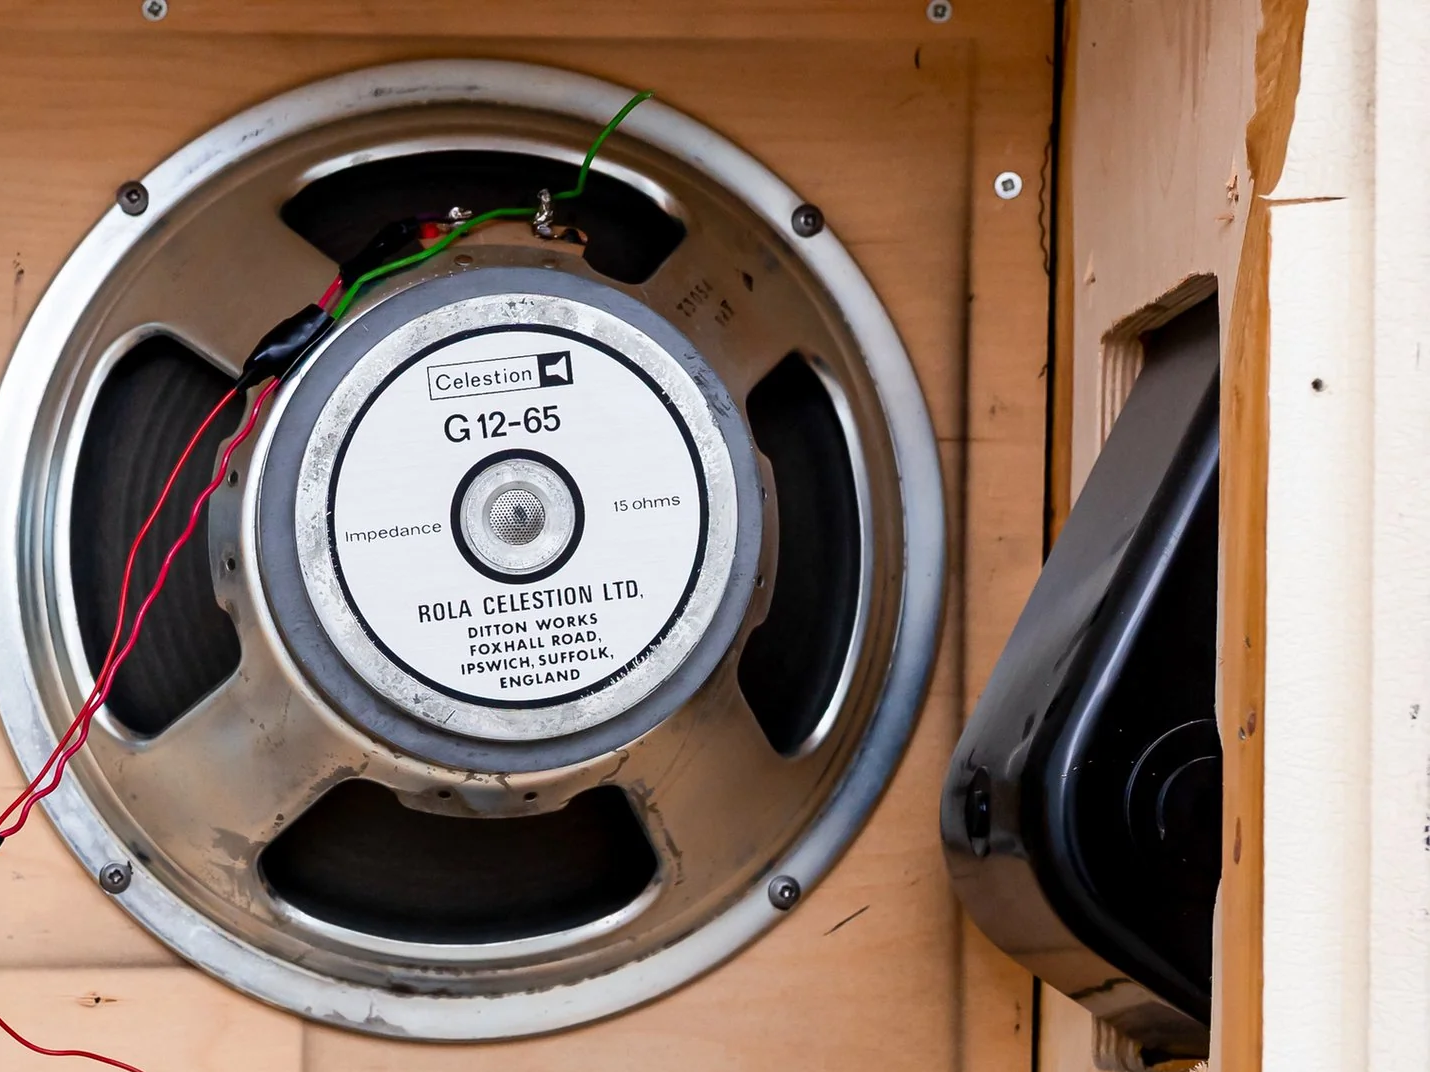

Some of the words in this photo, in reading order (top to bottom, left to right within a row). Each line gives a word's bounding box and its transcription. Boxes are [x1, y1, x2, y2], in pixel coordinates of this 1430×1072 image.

[434, 367, 533, 392] Celestion
[613, 499, 629, 512] 15
[632, 494, 681, 511] ohms
[345, 521, 442, 543] Impedance
[418, 599, 472, 623] ROLA
[483, 585, 592, 615] CELESTION
[468, 621, 528, 638] DITTON
[535, 613, 598, 630] WORKS
[470, 636, 545, 656] FOXHALL
[552, 630, 602, 647] ROAD,
[461, 656, 535, 675] IPSWICH,
[539, 647, 614, 666] SUFFOLK,
[500, 668, 581, 689] ENGLAND
